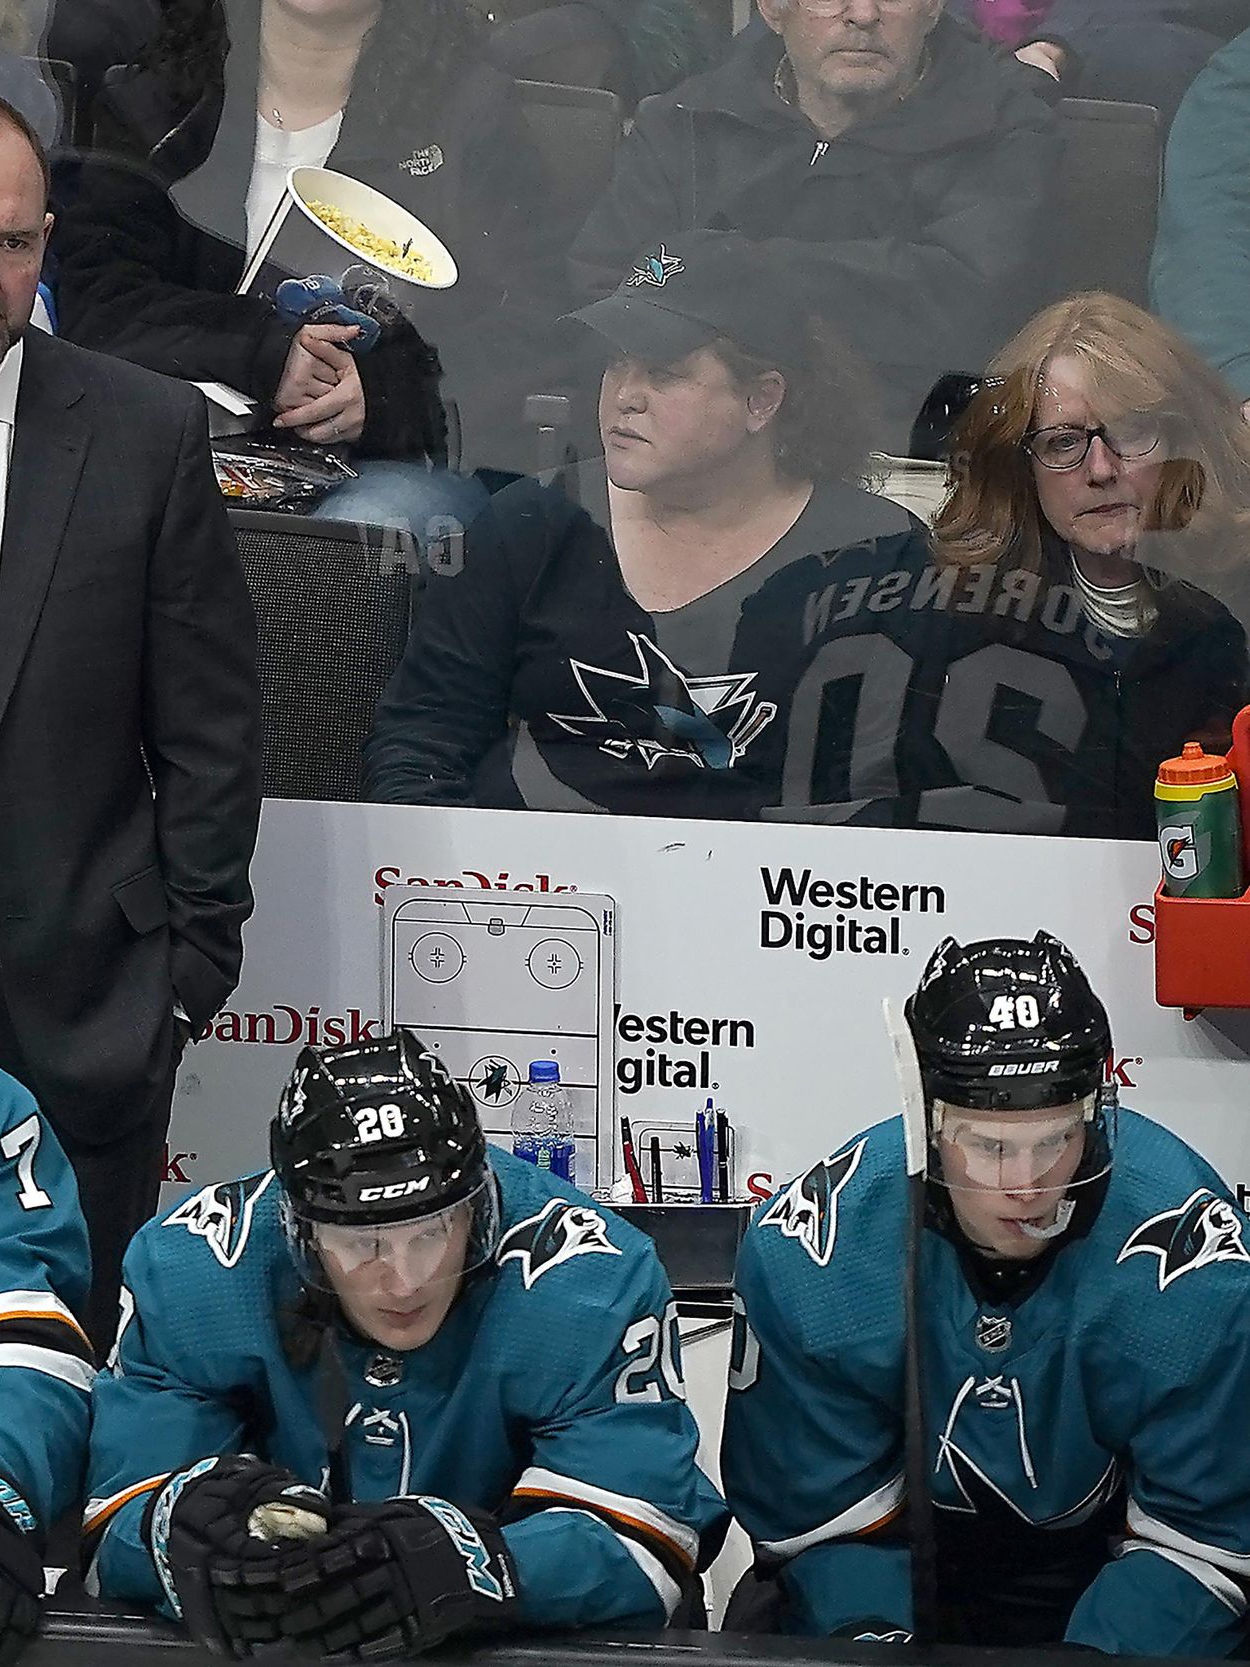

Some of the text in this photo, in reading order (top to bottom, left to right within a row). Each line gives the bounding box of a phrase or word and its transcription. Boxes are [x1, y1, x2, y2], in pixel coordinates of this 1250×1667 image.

[760, 867, 946, 913] Western
[760, 911, 900, 960] Digital
[614, 1003, 755, 1048] estern
[988, 995, 1040, 1030] 40
[616, 1048, 710, 1094] gital
[0, 1114, 52, 1210] 7
[358, 1175, 430, 1202] CCM
